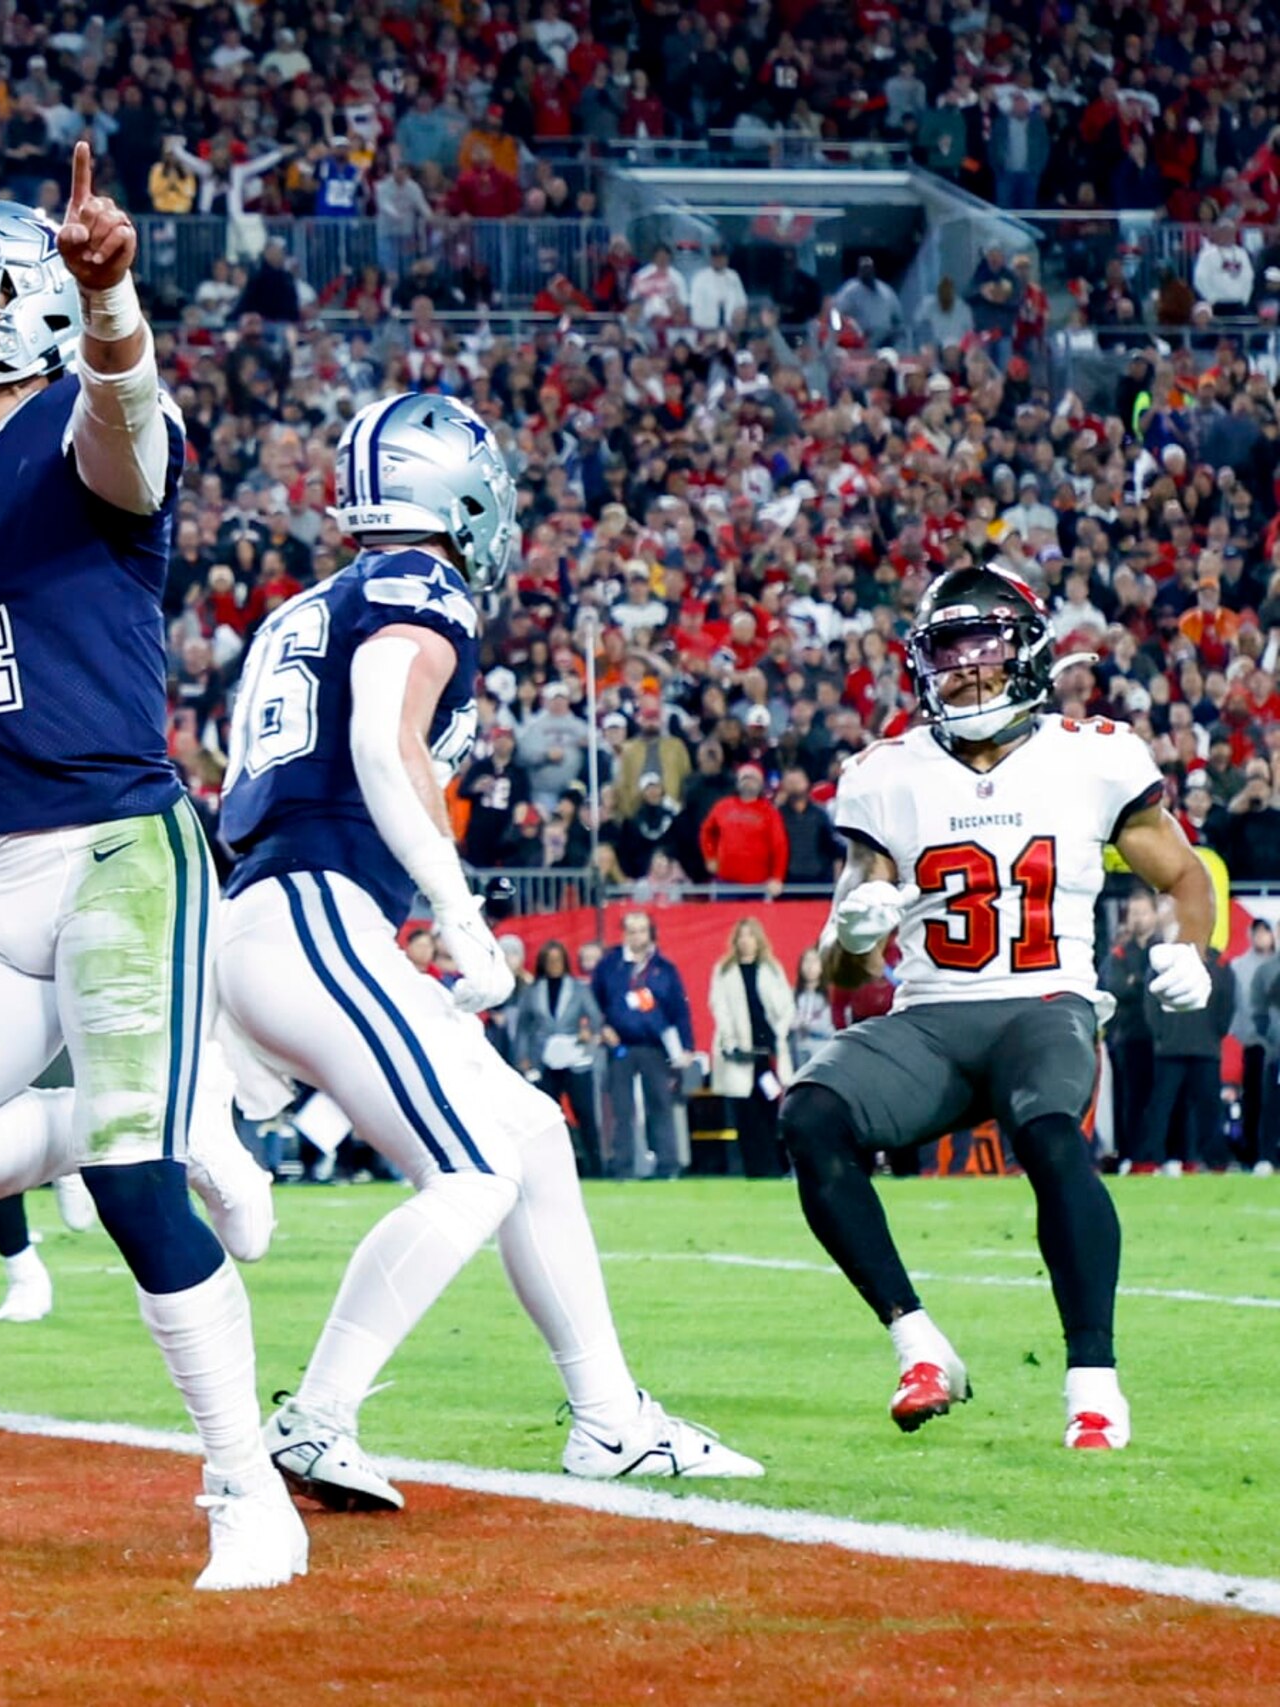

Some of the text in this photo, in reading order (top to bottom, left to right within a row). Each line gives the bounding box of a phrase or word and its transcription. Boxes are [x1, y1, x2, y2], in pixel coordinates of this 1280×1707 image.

[348, 513, 392, 525] BE LOVE
[949, 812, 1023, 831] BUCCANEERS
[914, 835, 1061, 973] 31
